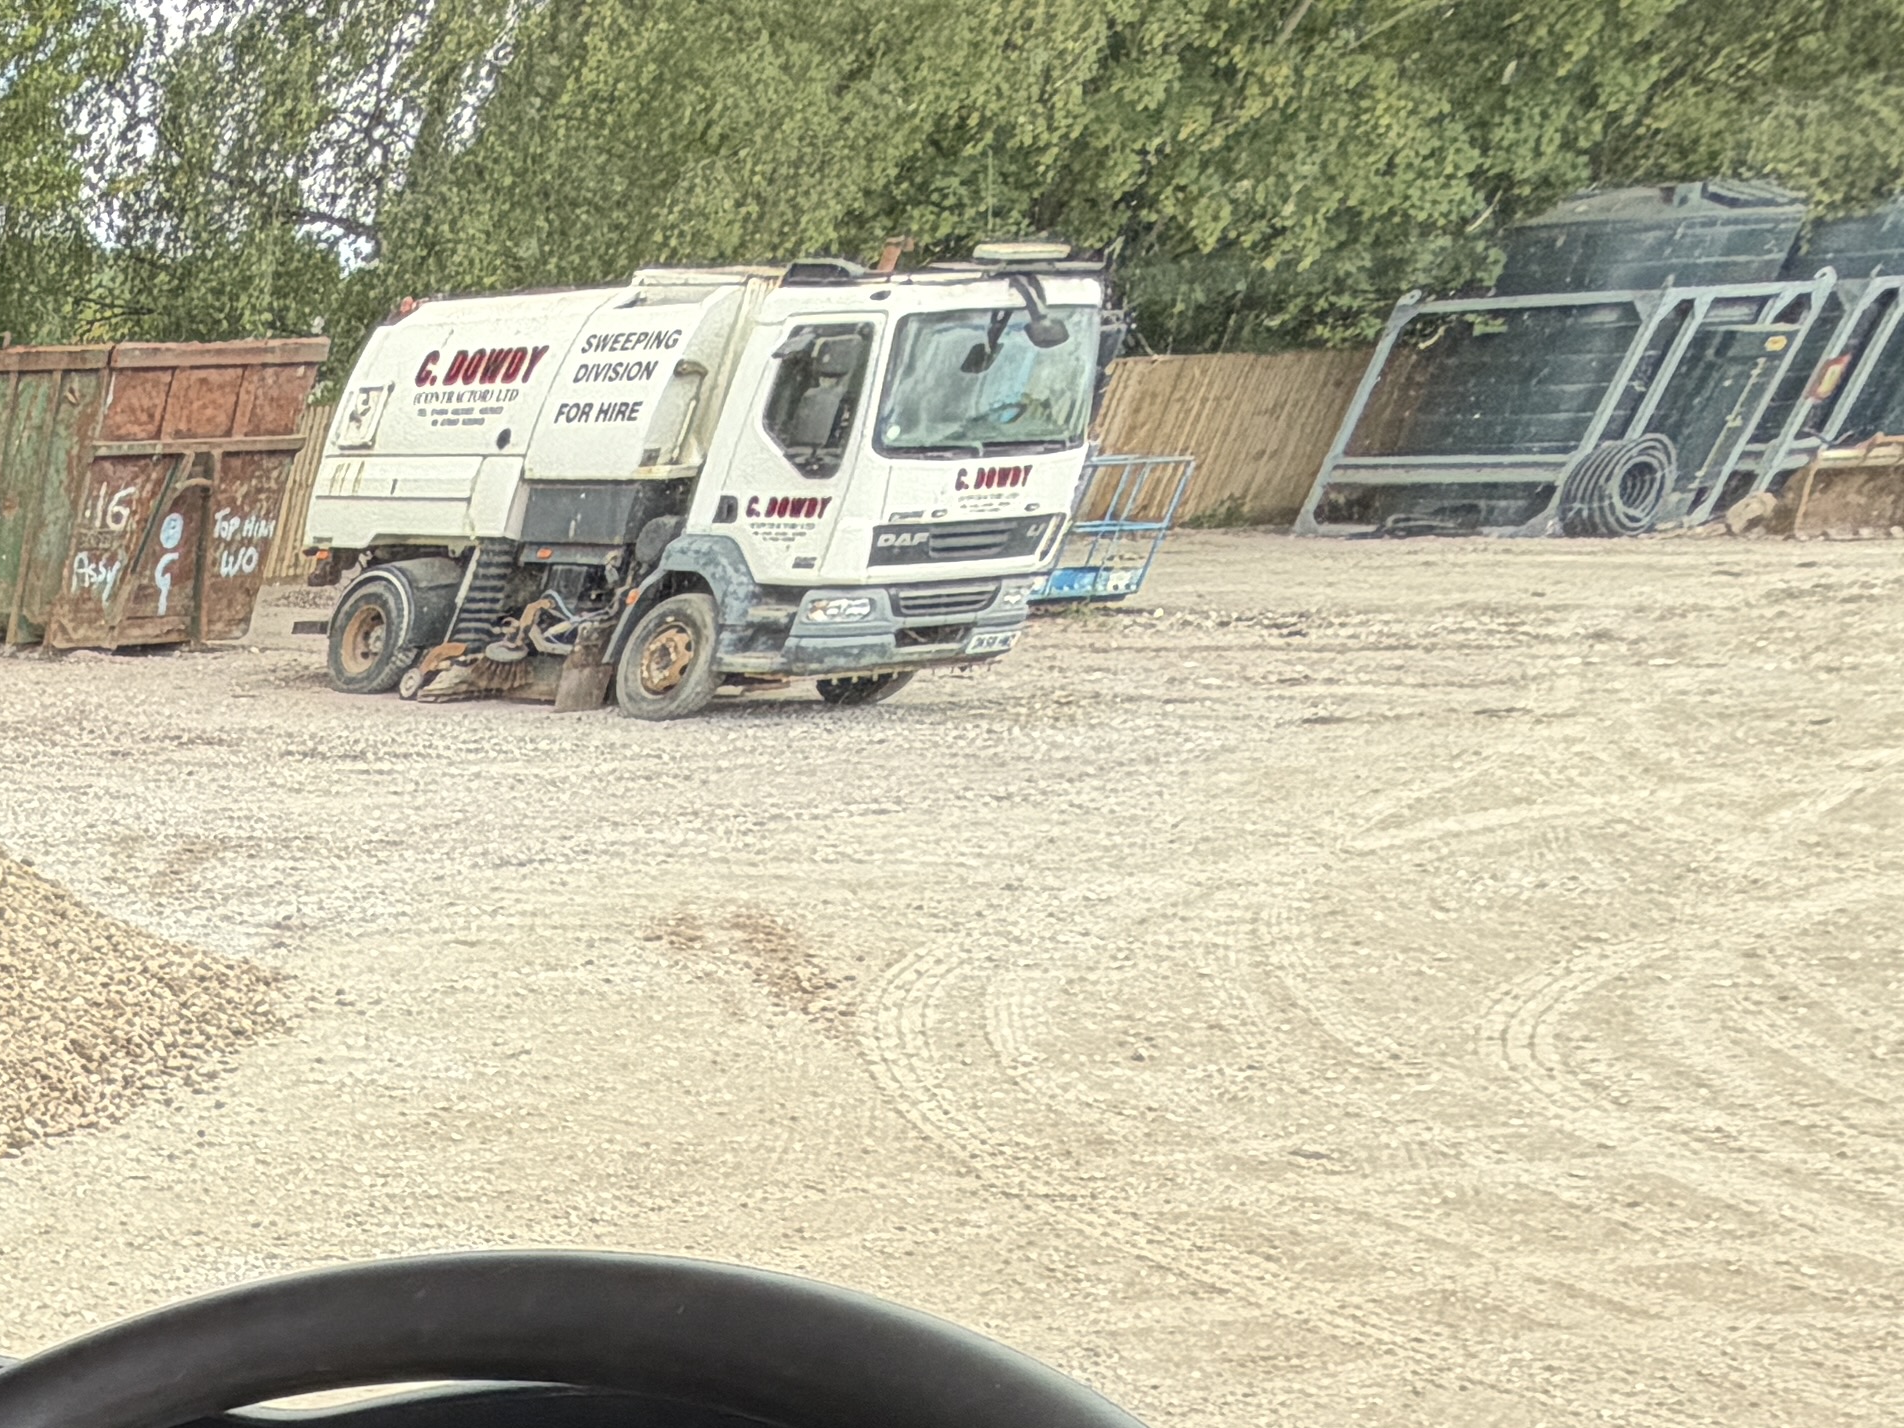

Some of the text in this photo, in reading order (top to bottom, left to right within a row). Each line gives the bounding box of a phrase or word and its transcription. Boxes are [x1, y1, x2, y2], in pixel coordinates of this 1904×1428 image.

[581, 329, 683, 354] SWEEPING
[442, 345, 550, 386] DOWDY
[572, 360, 659, 384] DIVISION
[495, 388, 520, 403] LTD
[554, 401, 644, 424] FOR HIRE
[973, 464, 1034, 490] DOWDY
[764, 495, 833, 519] DOWDY
[876, 532, 931, 547] DAF
